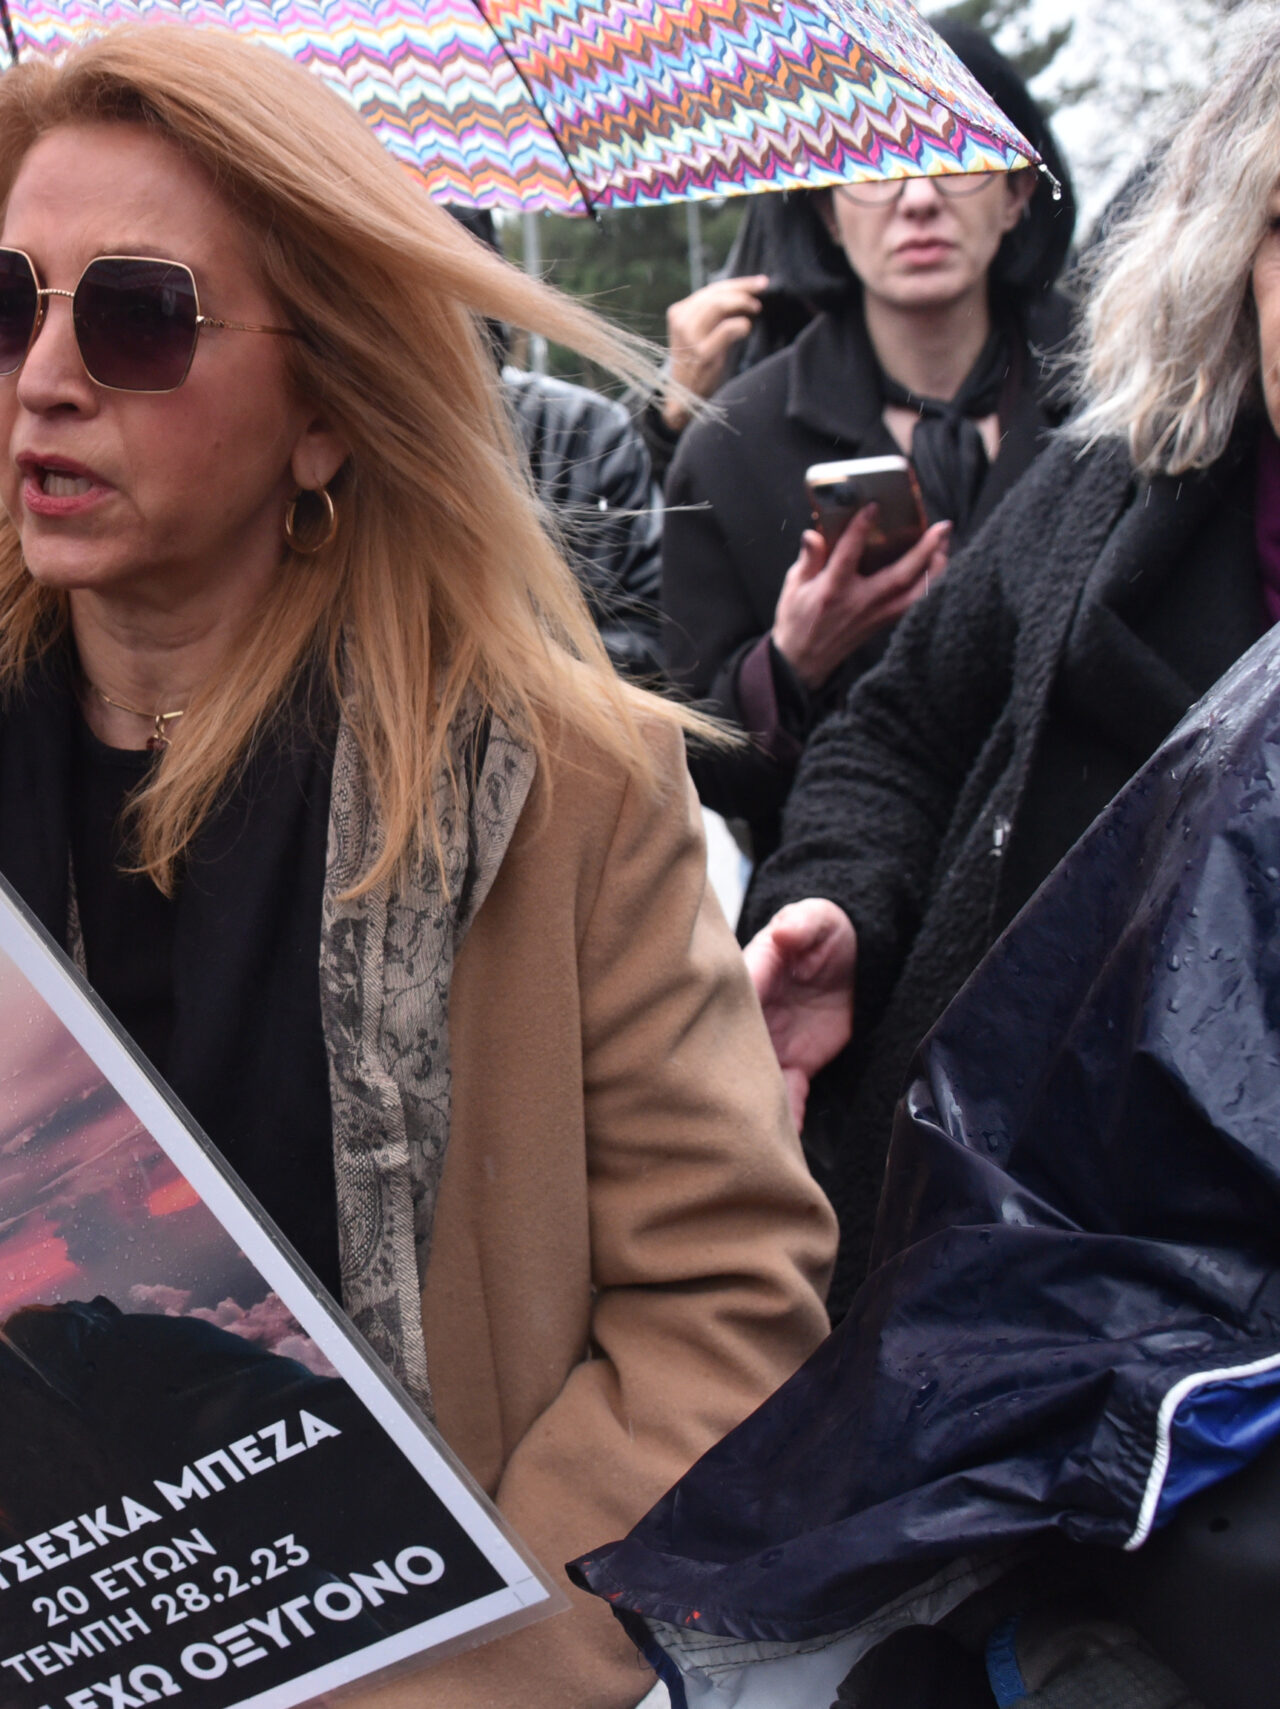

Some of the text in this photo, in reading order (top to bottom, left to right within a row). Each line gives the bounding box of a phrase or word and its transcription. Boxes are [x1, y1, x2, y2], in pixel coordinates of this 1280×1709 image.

[153, 1409, 342, 1512] ΜΠΕΖΑ
[0, 1533, 310, 1683] ΤΕΜΠΗ 28.2.23
[32, 1528, 218, 1628] 20 ΕΤΩΝ
[180, 1545, 446, 1681] ΟΞΥΓΟΝΟ
